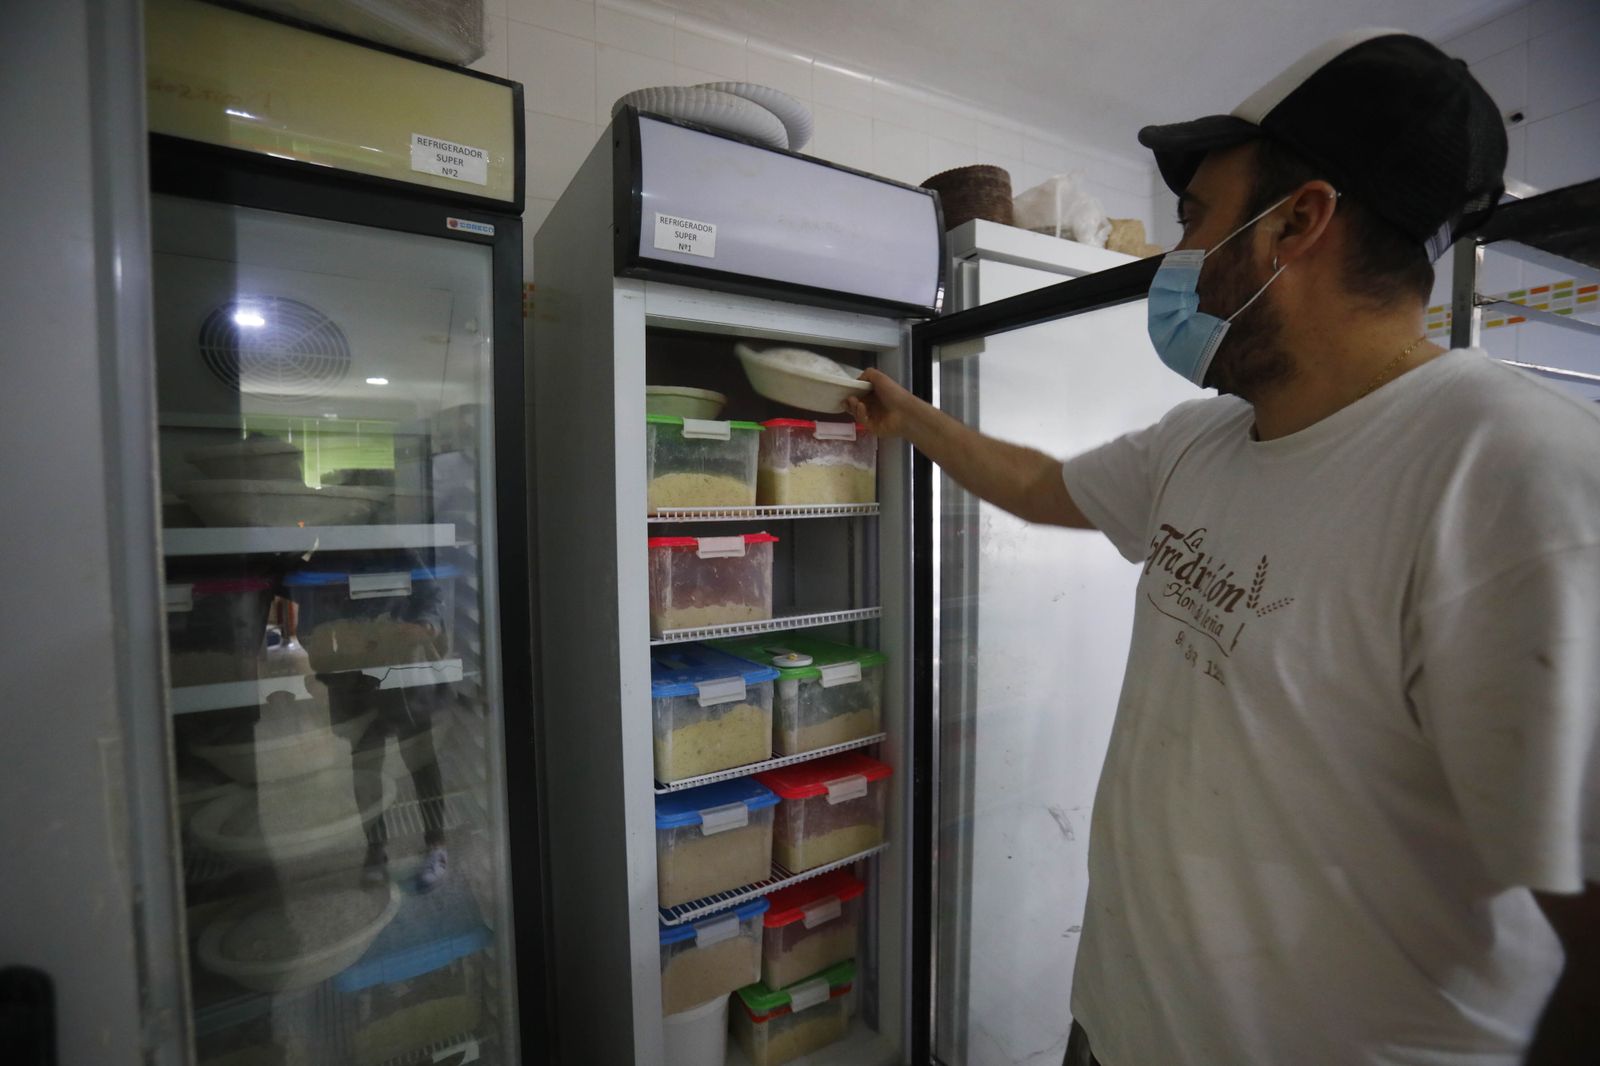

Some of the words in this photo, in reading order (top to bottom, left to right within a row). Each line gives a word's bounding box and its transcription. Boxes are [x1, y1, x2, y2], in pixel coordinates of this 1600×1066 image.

[416, 136, 483, 159] REFRIGERADOR
[436, 153, 464, 167] SUPER
[441, 167, 459, 178] Nº2
[659, 216, 713, 233] REFRIGERADOR
[674, 230, 697, 241] SUPER
[678, 242, 692, 252] Nº1
[1183, 528, 1207, 553] La
